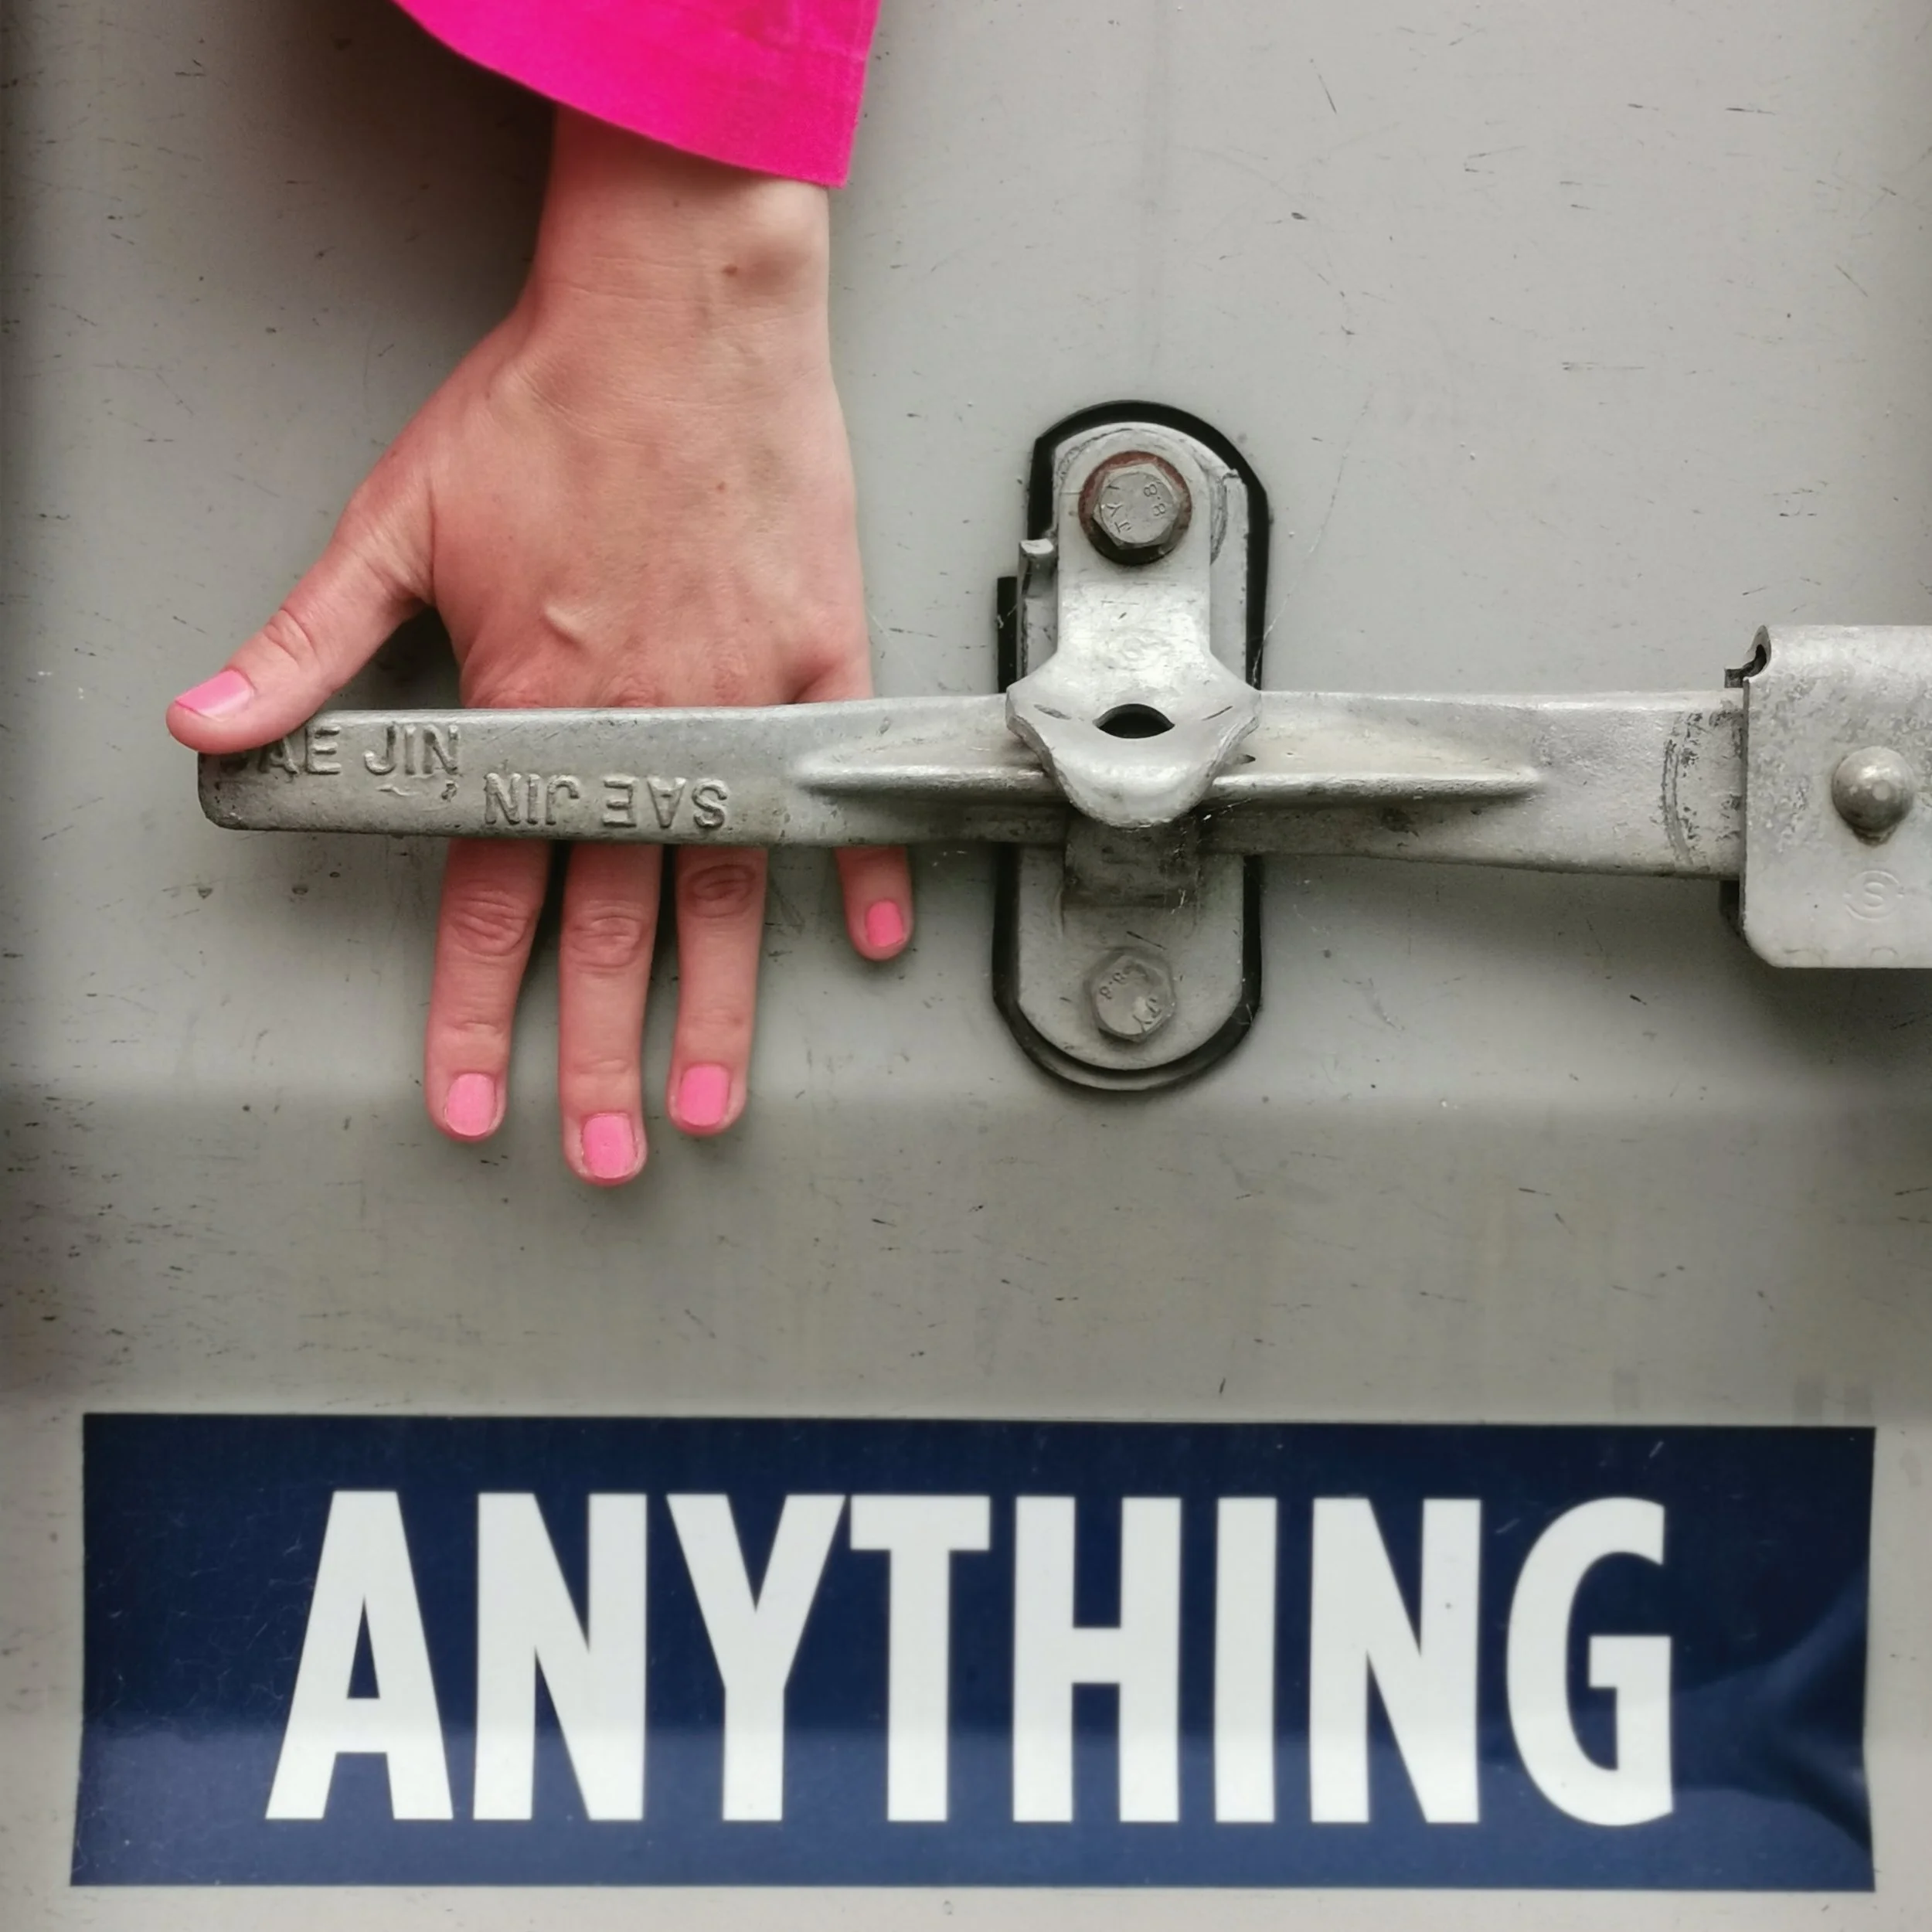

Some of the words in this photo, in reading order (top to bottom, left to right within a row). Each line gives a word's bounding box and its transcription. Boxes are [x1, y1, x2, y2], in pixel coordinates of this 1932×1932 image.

[1143, 483, 1166, 518] 8.8
[362, 722, 461, 776] JIN
[482, 773, 582, 829] JIN
[599, 775, 730, 832] SAE
[266, 1492, 1672, 1825] ANYTHING
